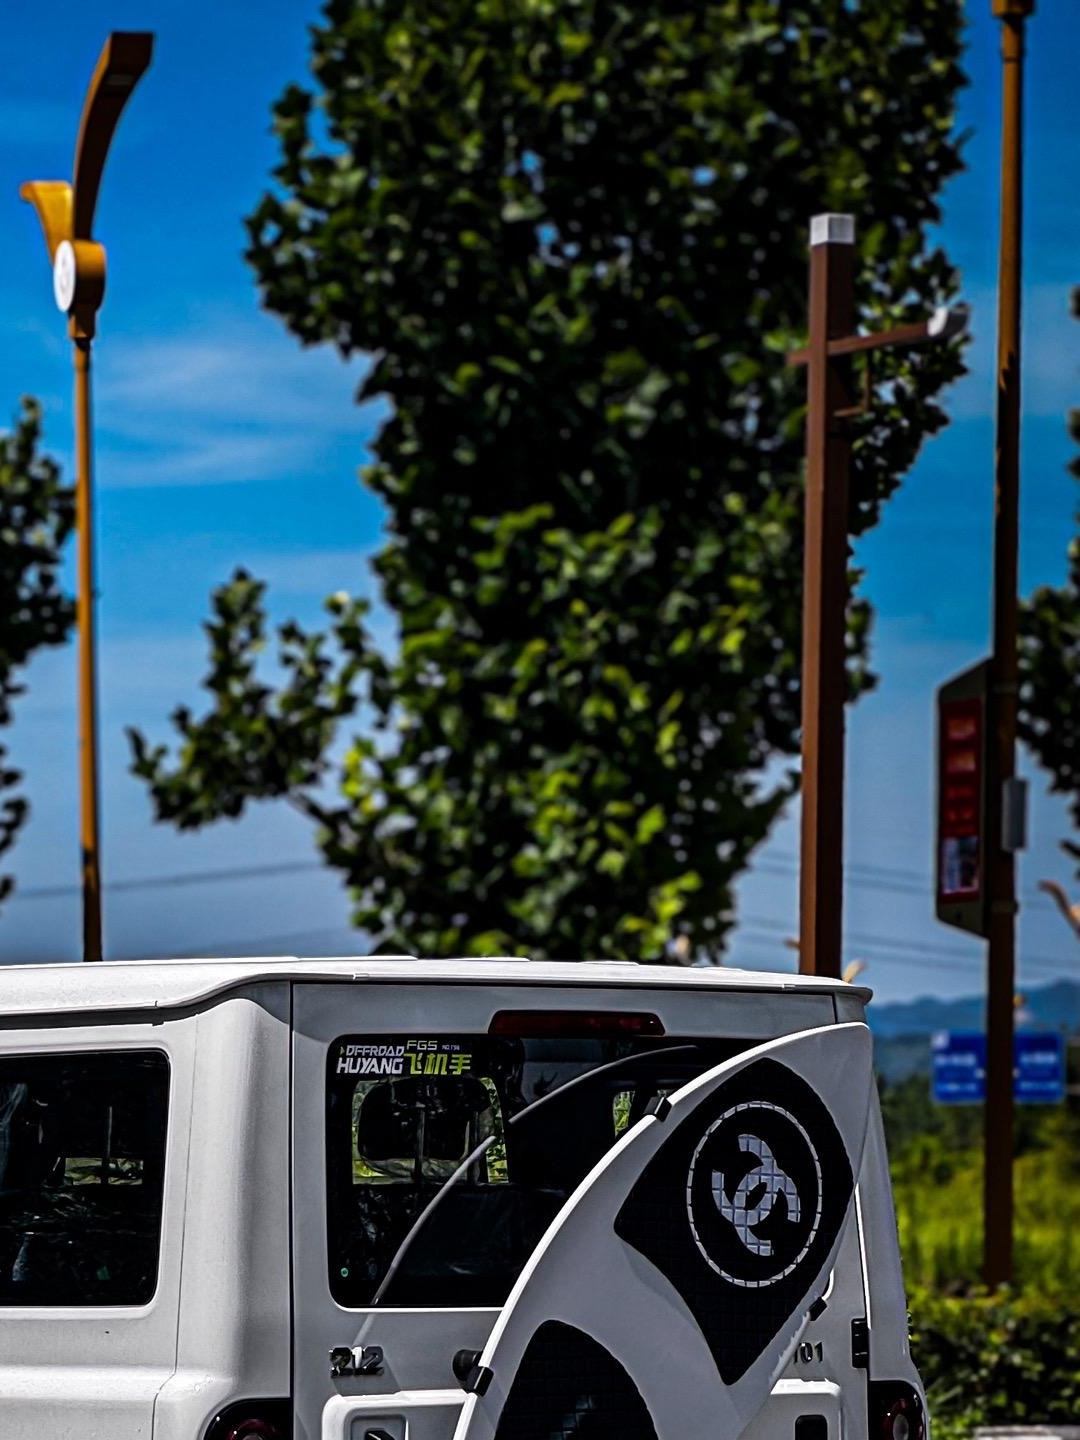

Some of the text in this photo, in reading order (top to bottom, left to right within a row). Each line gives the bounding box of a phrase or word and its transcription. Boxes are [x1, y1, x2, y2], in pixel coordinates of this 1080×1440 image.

[344, 1045, 405, 1057] OFFROAD
[406, 1040, 438, 1051] FGS
[336, 1057, 404, 1075] HUYANG
[404, 1052, 472, 1075] 飞机手
[329, 1345, 384, 1377] 212
